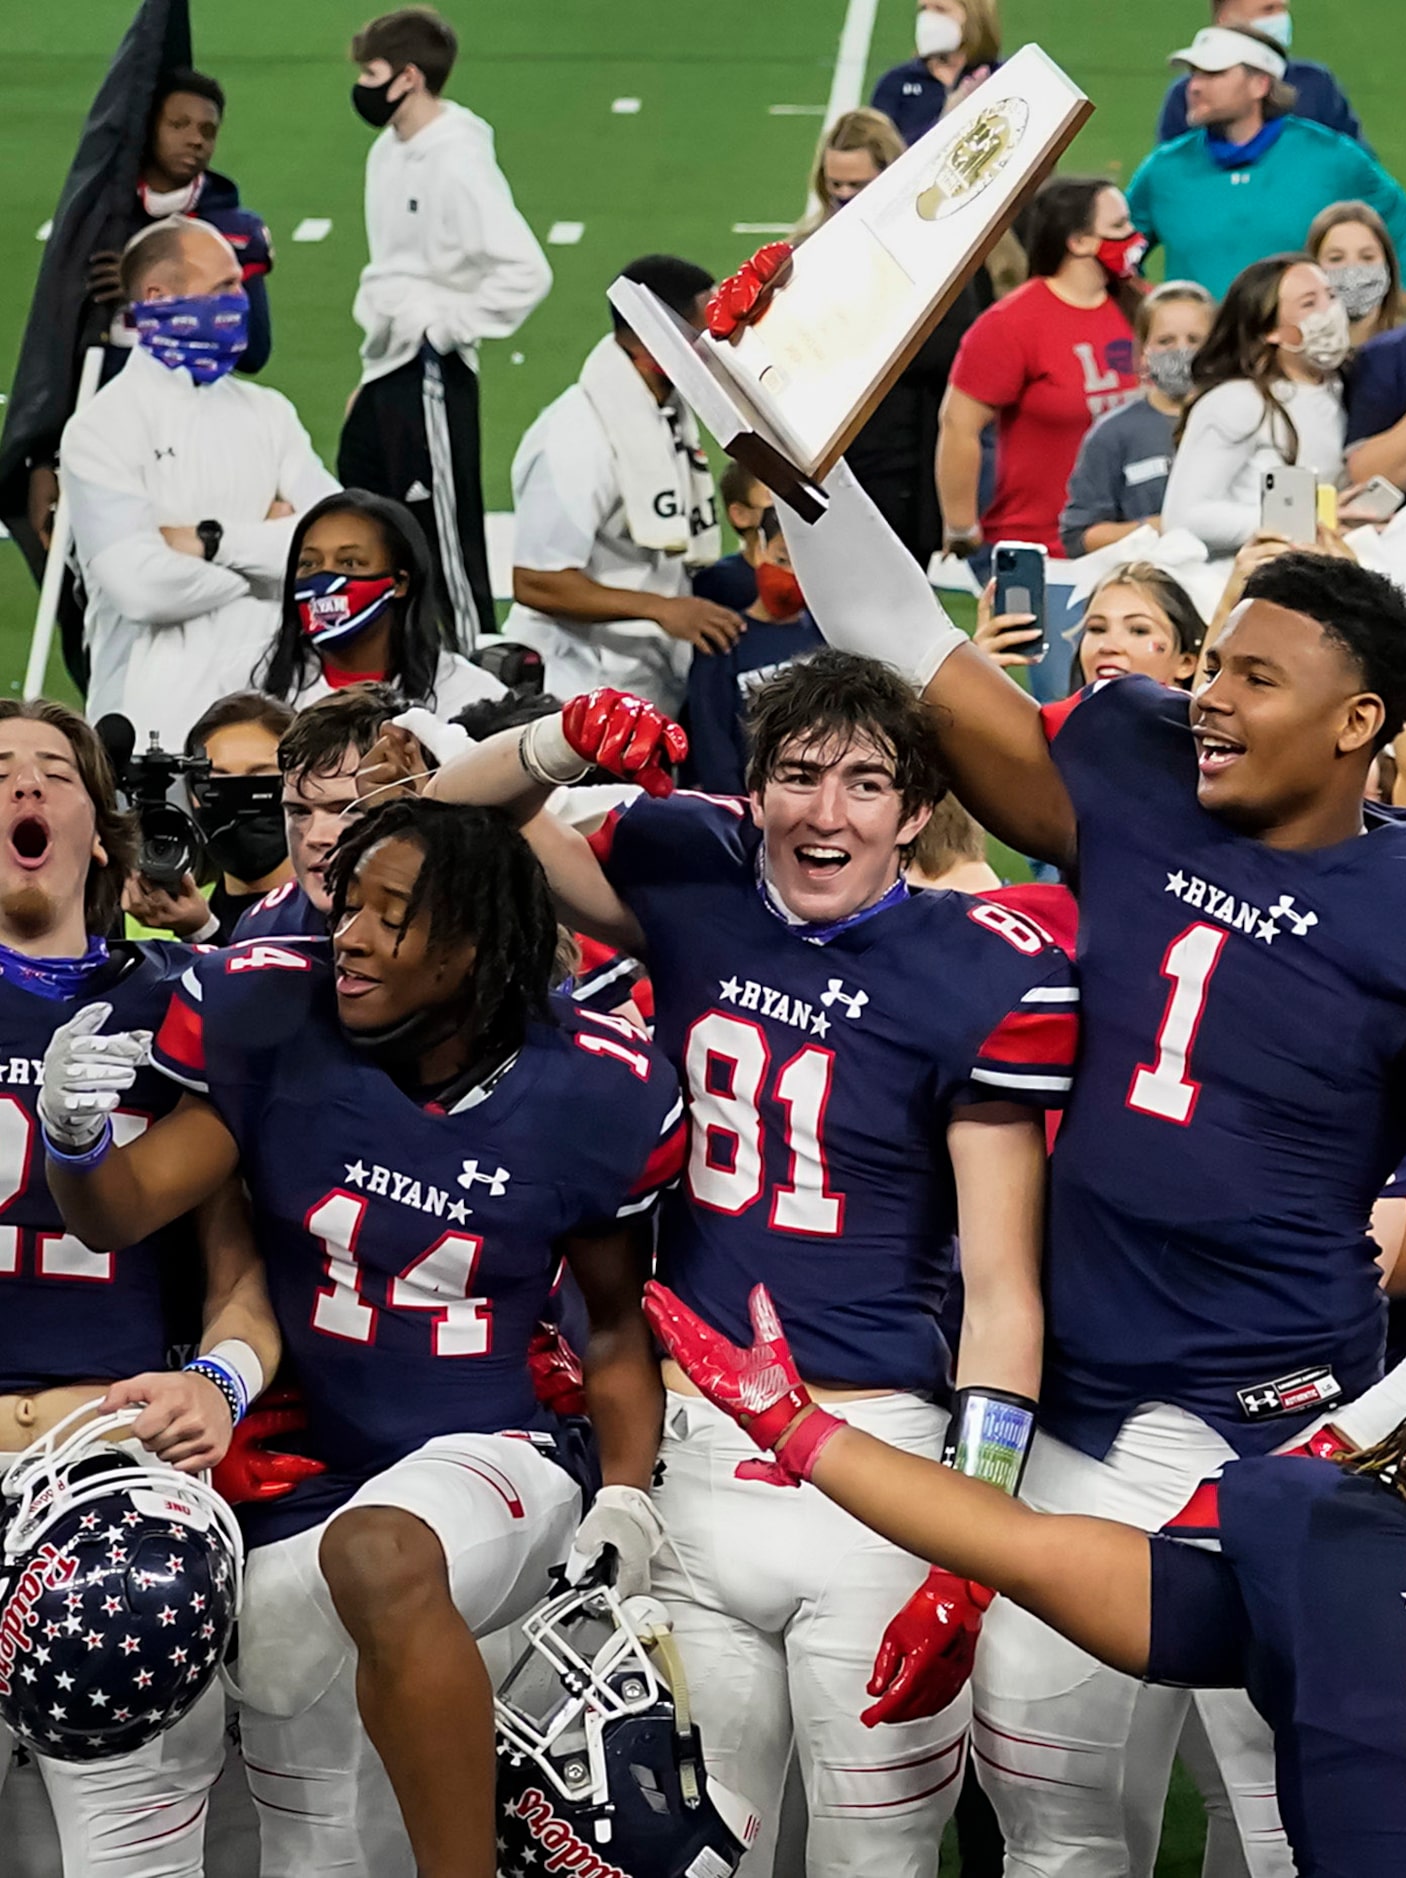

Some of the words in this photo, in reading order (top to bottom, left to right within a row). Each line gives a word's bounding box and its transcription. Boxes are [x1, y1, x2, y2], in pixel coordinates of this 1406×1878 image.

[1183, 876, 1261, 935] RYAN
[738, 979, 813, 1030] RYAN
[1124, 921, 1230, 1127] 1
[683, 1007, 846, 1238] 81
[366, 1165, 450, 1217] RYAN
[302, 1186, 494, 1359] 14
